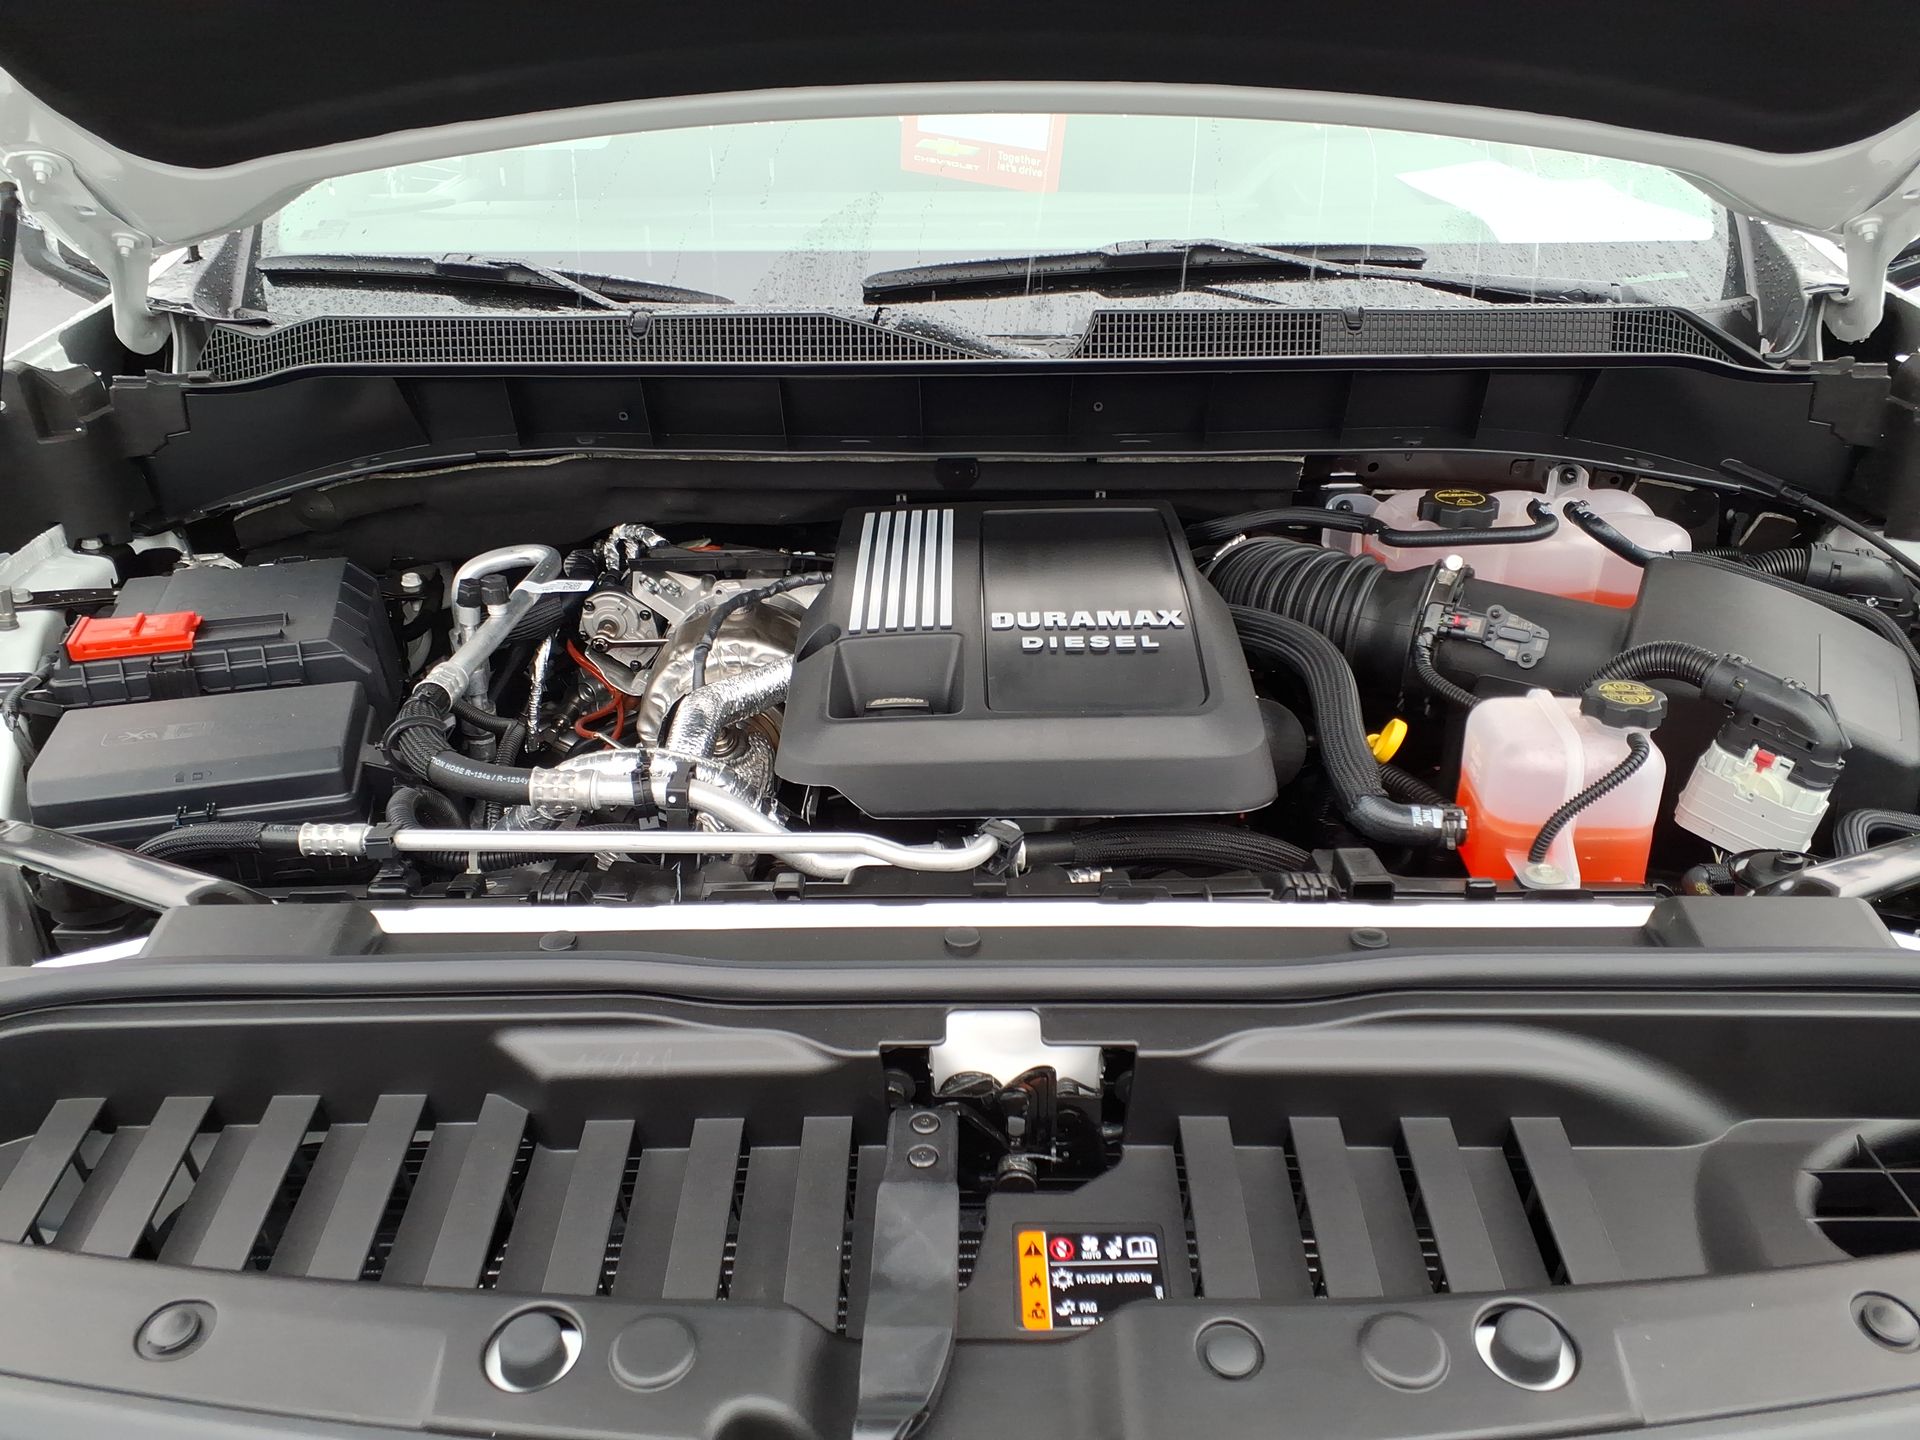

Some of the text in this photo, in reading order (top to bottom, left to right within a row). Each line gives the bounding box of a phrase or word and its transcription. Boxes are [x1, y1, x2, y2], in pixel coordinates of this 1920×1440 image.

[914, 155, 981, 171] CHEVROLET
[997, 150, 1041, 166] Together
[997, 161, 1044, 177] let's drive
[991, 609, 1186, 629] DURAMAX
[1021, 635, 1161, 650] DIESEL
[444, 762, 465, 775] HOSE
[1081, 1251, 1102, 1260] AUTO
[1140, 1272, 1152, 1284] kg
